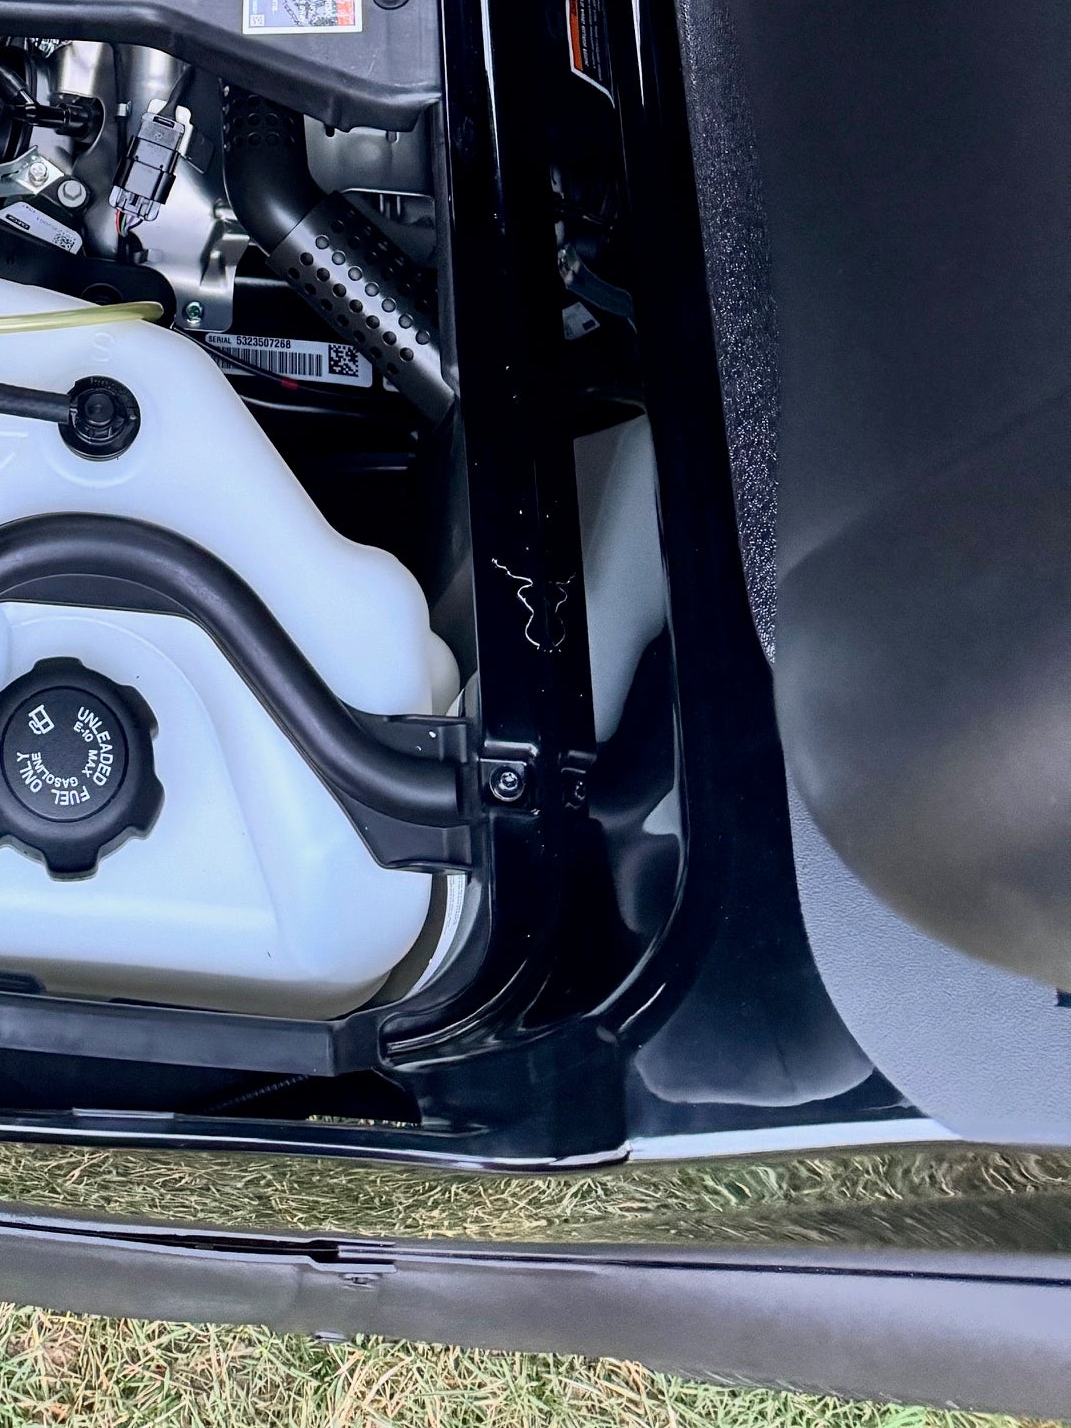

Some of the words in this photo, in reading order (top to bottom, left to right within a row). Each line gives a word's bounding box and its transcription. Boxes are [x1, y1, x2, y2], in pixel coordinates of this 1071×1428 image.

[209, 335, 231, 344] SERIAL
[73, 722, 93, 743] E-10
[78, 707, 114, 786] UNLEADED
[17, 752, 42, 793] ONLY
[32, 752, 78, 788] GASOLINE
[82, 750, 97, 778] MAX
[51, 786, 90, 805] FUEL
